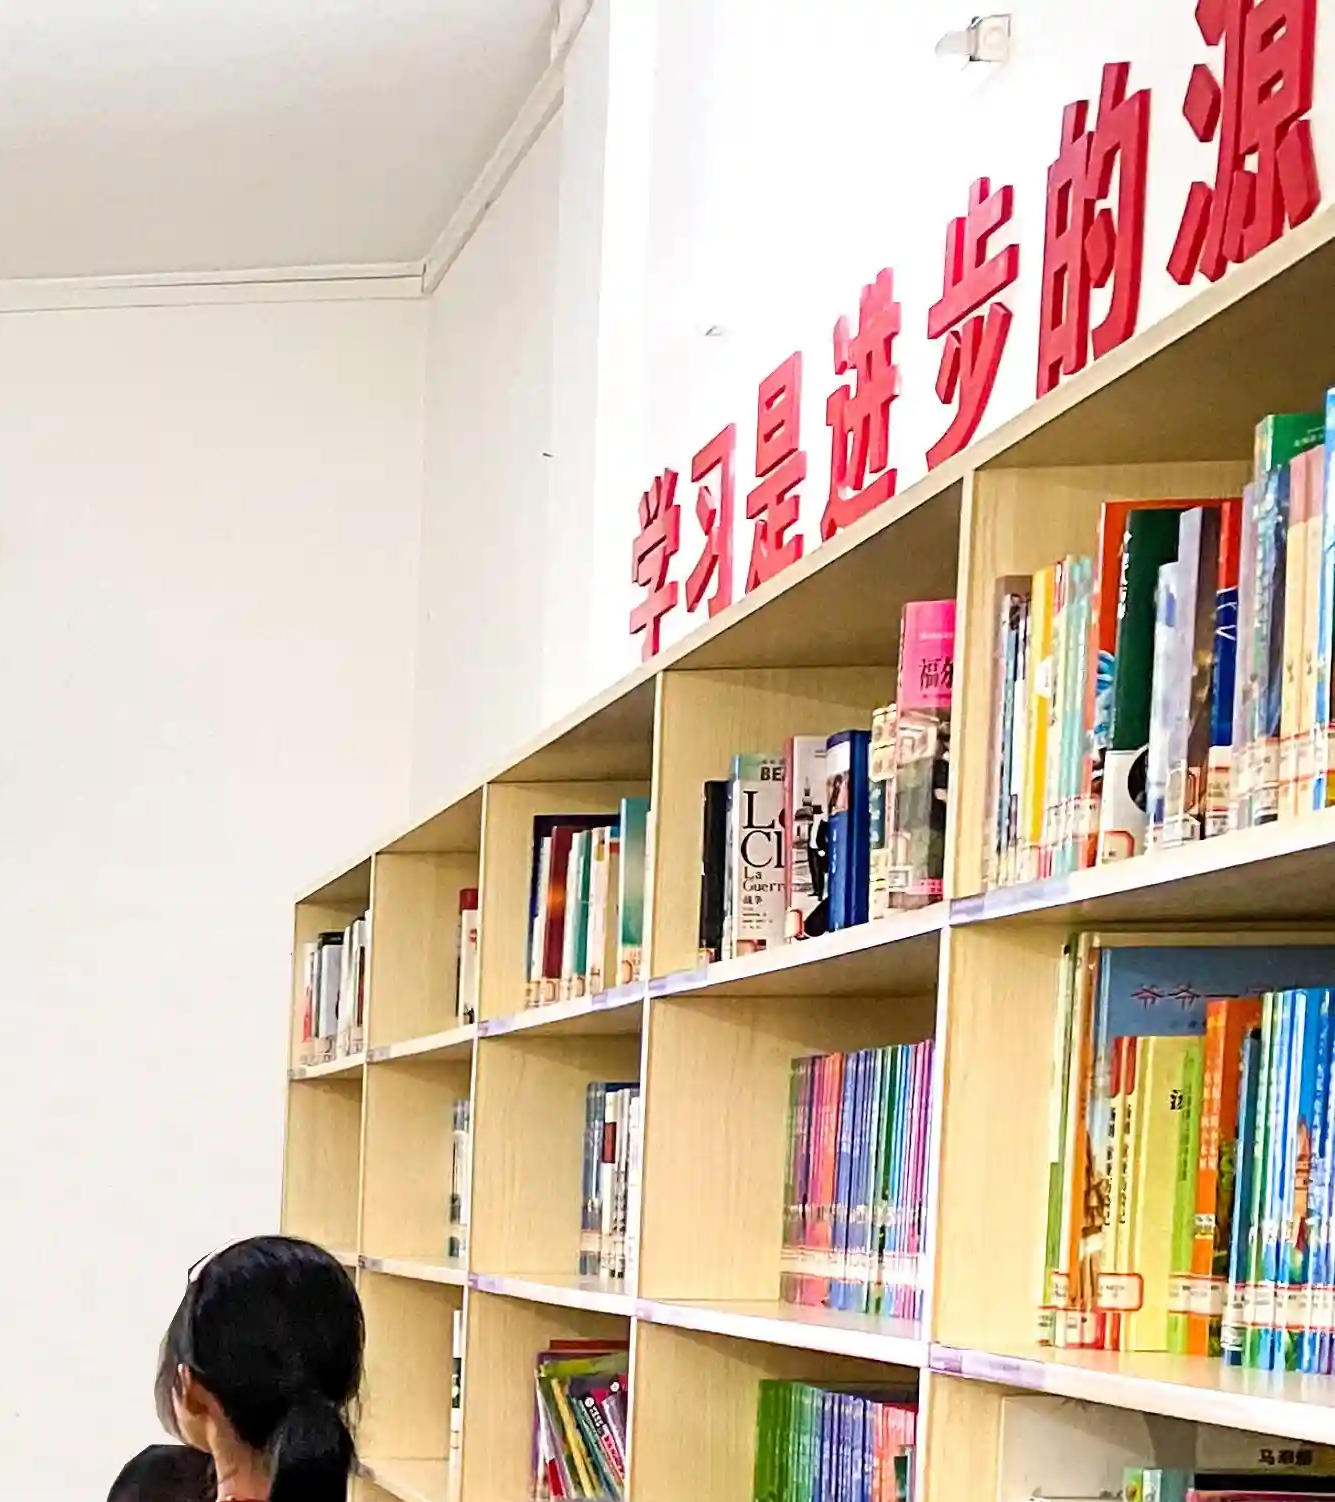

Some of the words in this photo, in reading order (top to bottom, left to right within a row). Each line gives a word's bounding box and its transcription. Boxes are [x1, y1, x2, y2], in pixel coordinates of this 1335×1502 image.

[630, 0, 1322, 656] 学习是进步的源
